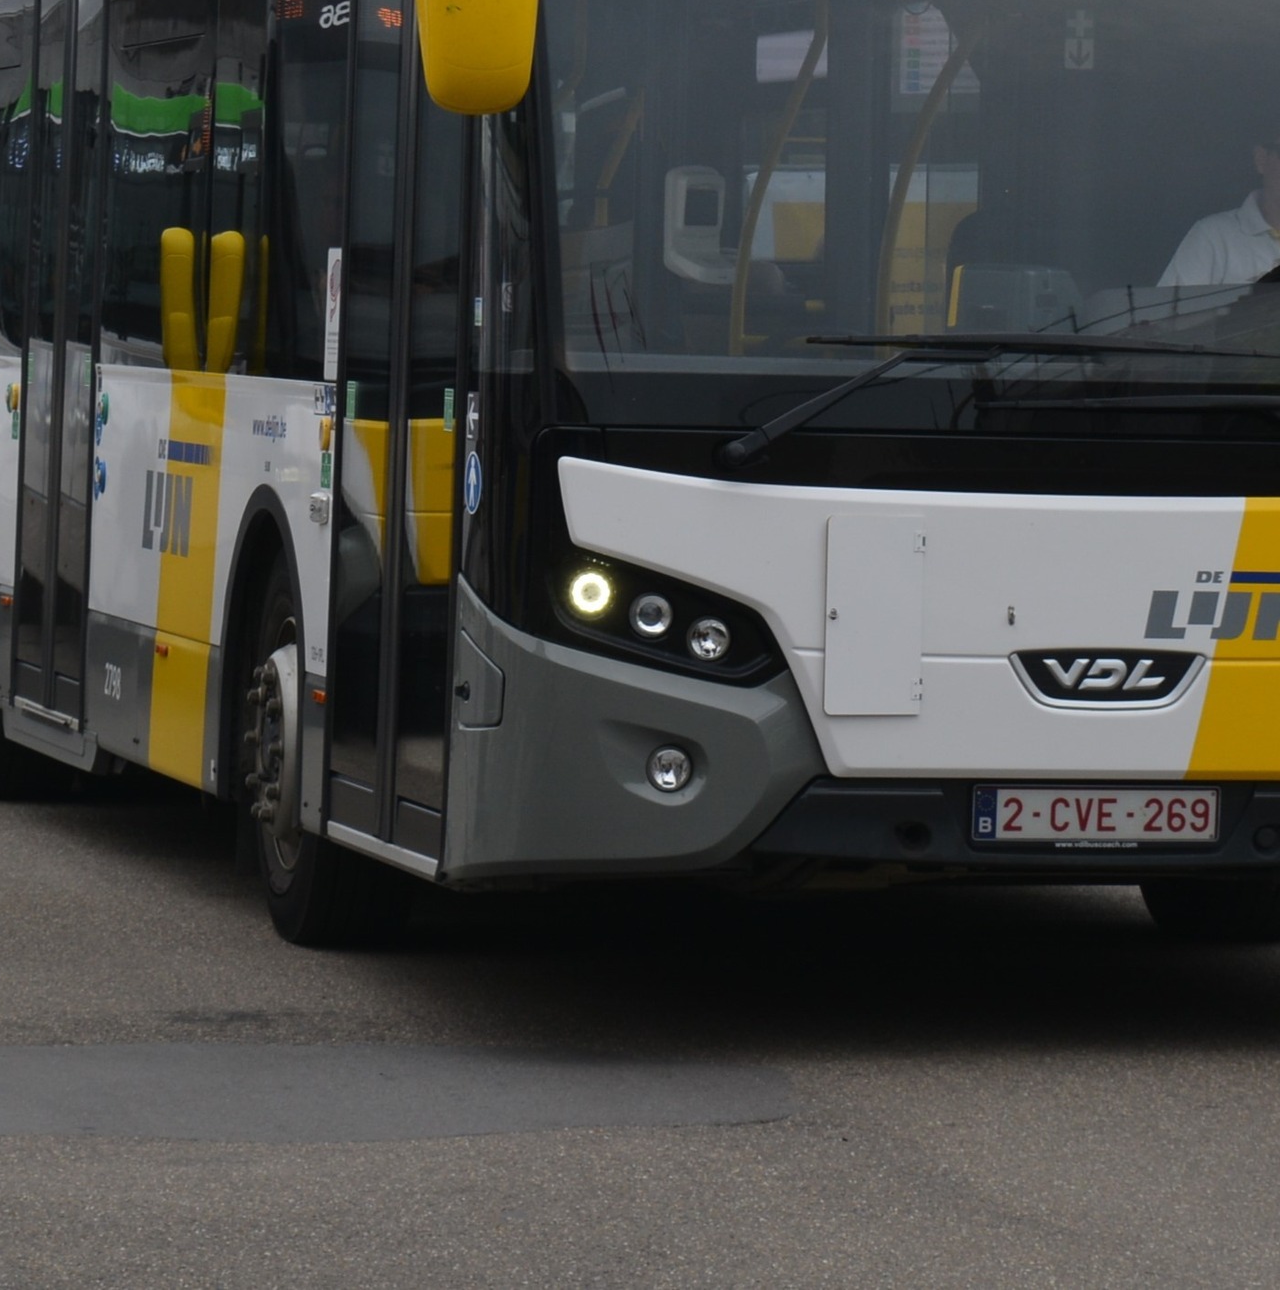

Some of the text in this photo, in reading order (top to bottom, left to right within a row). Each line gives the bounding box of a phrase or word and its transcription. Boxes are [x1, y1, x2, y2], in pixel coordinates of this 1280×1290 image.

[158, 439, 167, 460] DE
[141, 470, 194, 558] LIJN
[1196, 570, 1224, 584] DE
[104, 662, 121, 700] 2798
[1041, 658, 1167, 692] VDL
[978, 817, 993, 833] B
